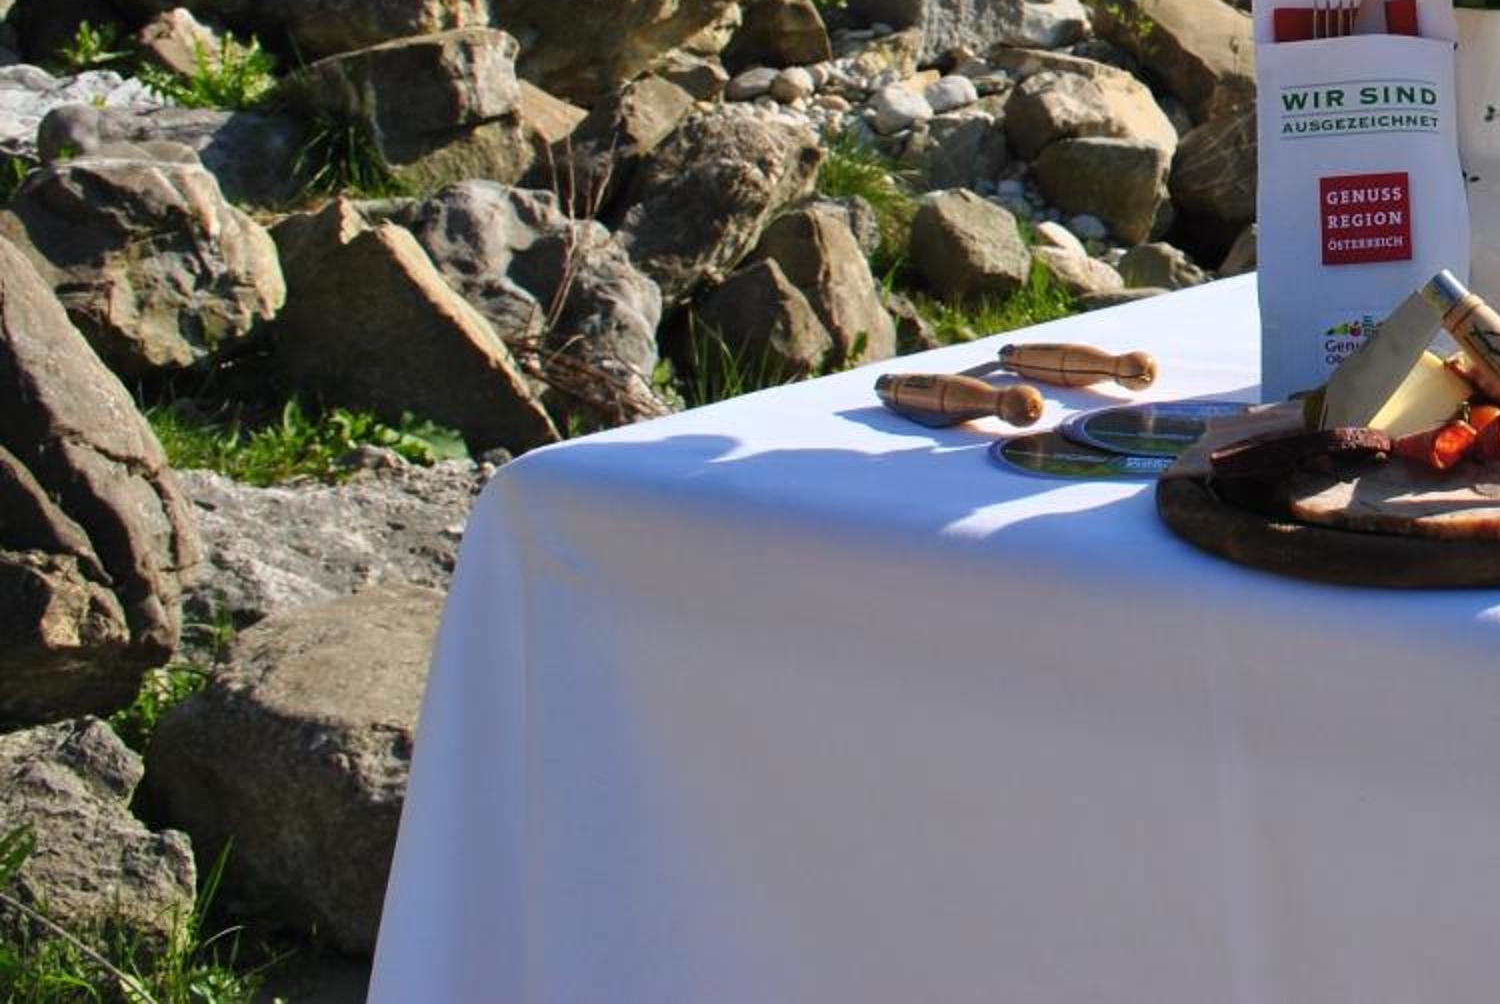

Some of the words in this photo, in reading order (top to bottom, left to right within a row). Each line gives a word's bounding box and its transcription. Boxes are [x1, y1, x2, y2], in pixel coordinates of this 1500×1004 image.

[1282, 89, 1344, 111] WIR
[1359, 86, 1438, 106] SIND
[1281, 114, 1440, 134] AUSGEZEICHNET
[1326, 186, 1403, 206] GENUSS
[1326, 211, 1403, 230] REGION
[1326, 235, 1404, 252] ÖSTERREICH
